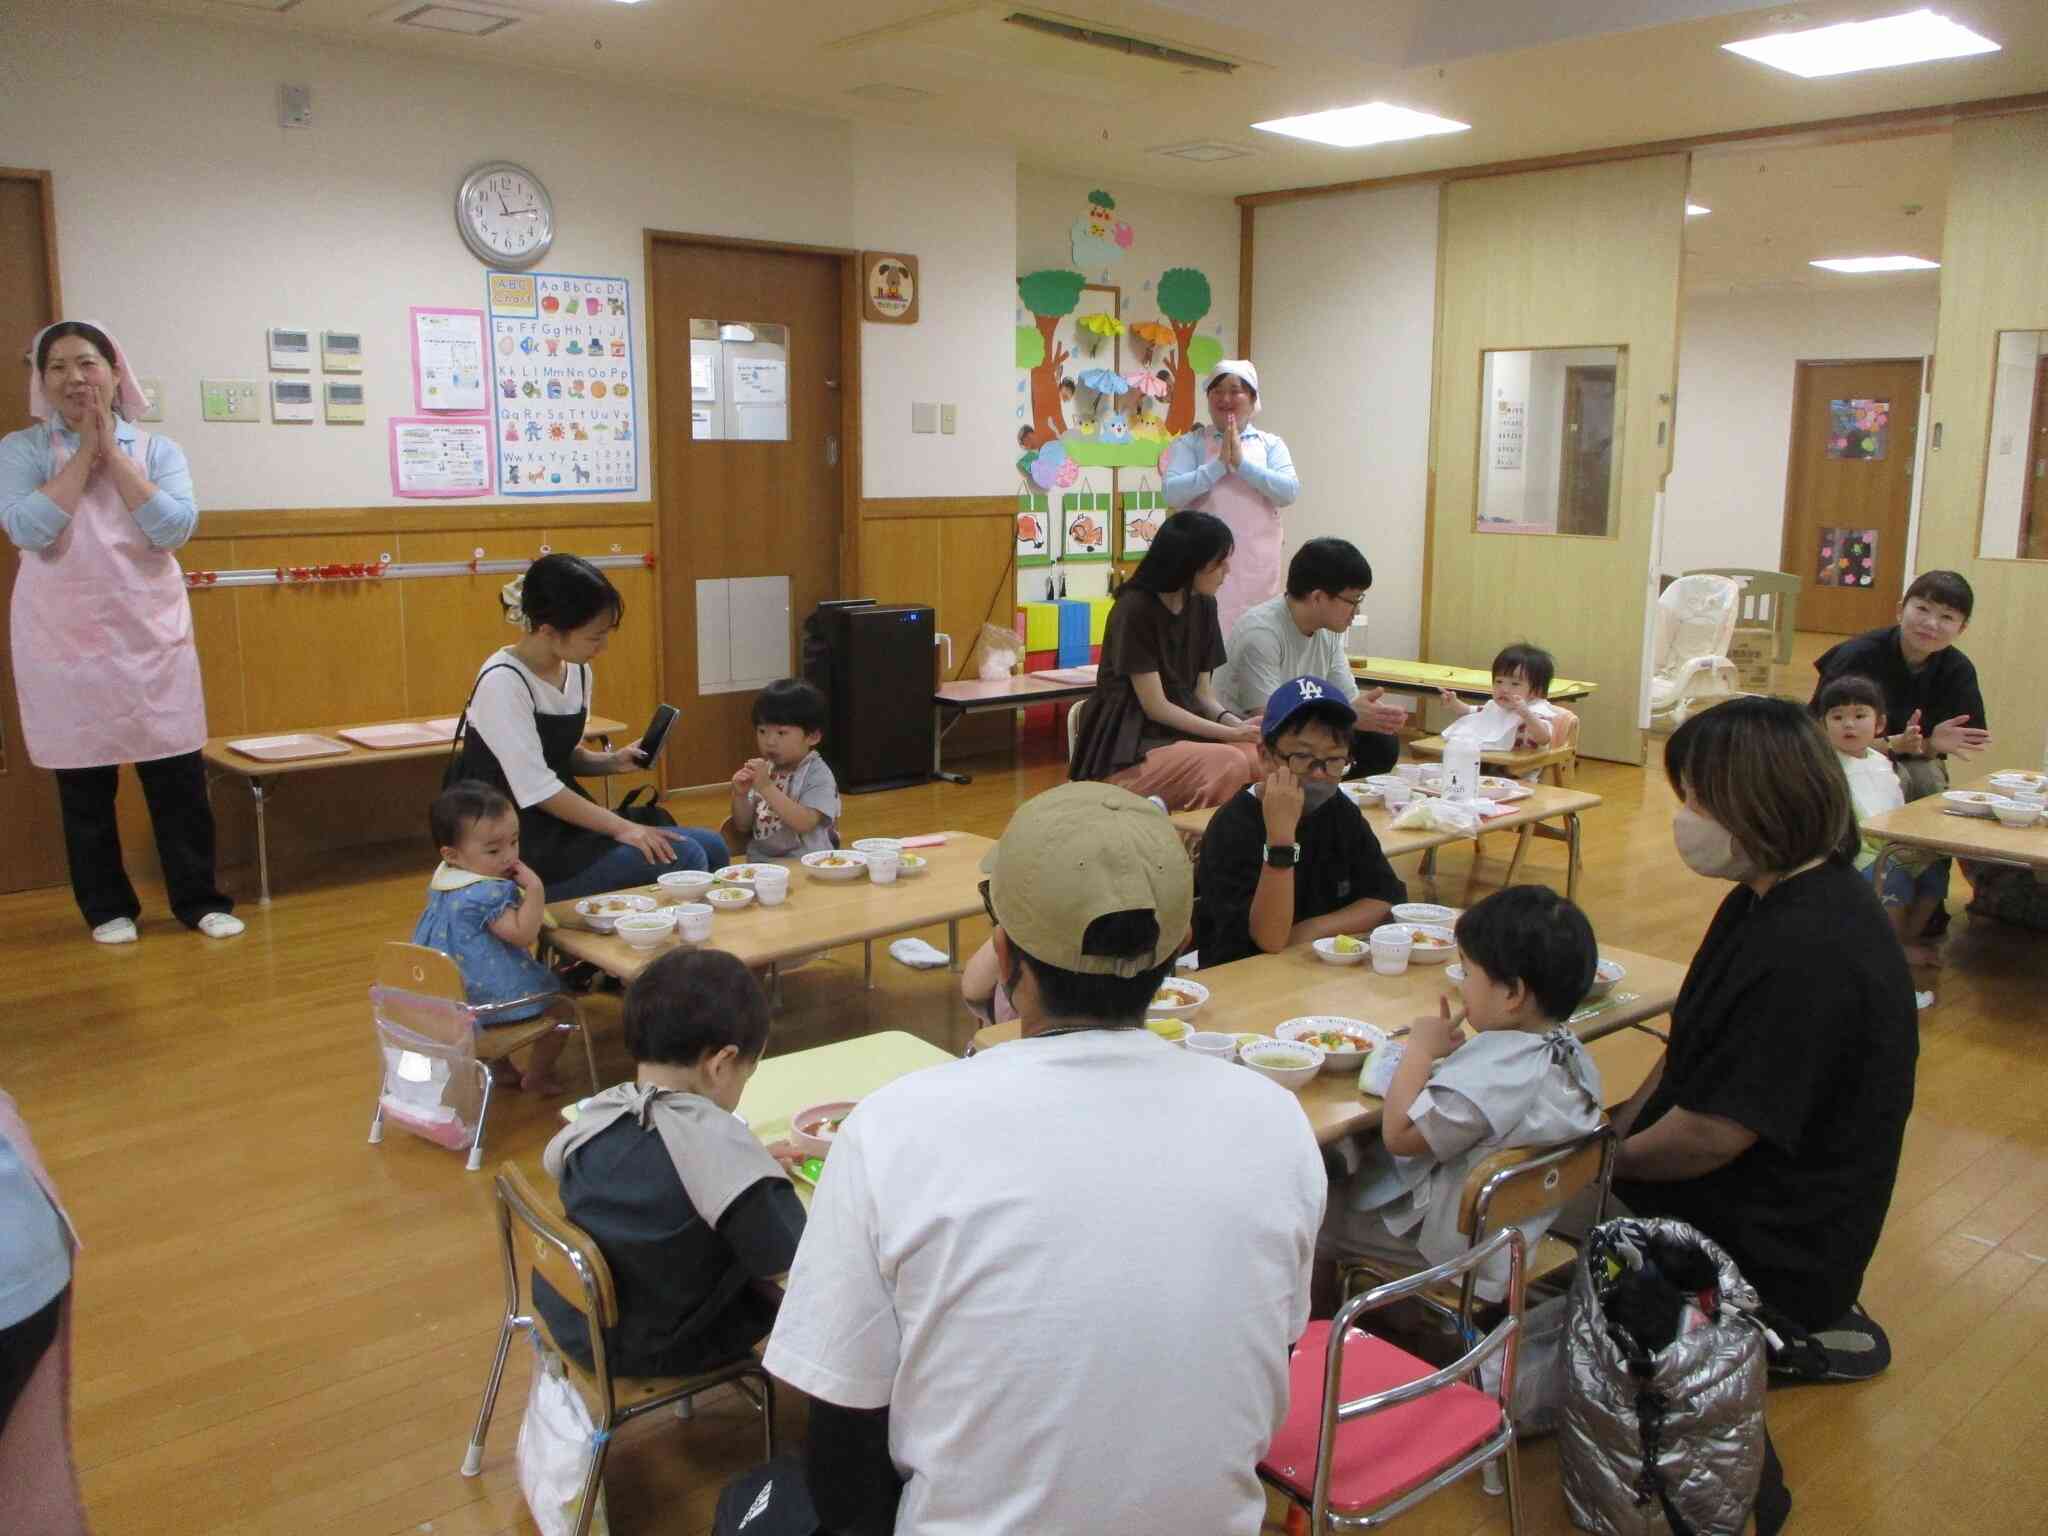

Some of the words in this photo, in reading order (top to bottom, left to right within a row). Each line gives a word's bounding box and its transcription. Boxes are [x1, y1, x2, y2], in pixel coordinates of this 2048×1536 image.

[489, 179, 497, 193] 11
[501, 176, 512, 190] 12
[504, 237, 512, 249] 6
[1296, 679, 1323, 700] LA
